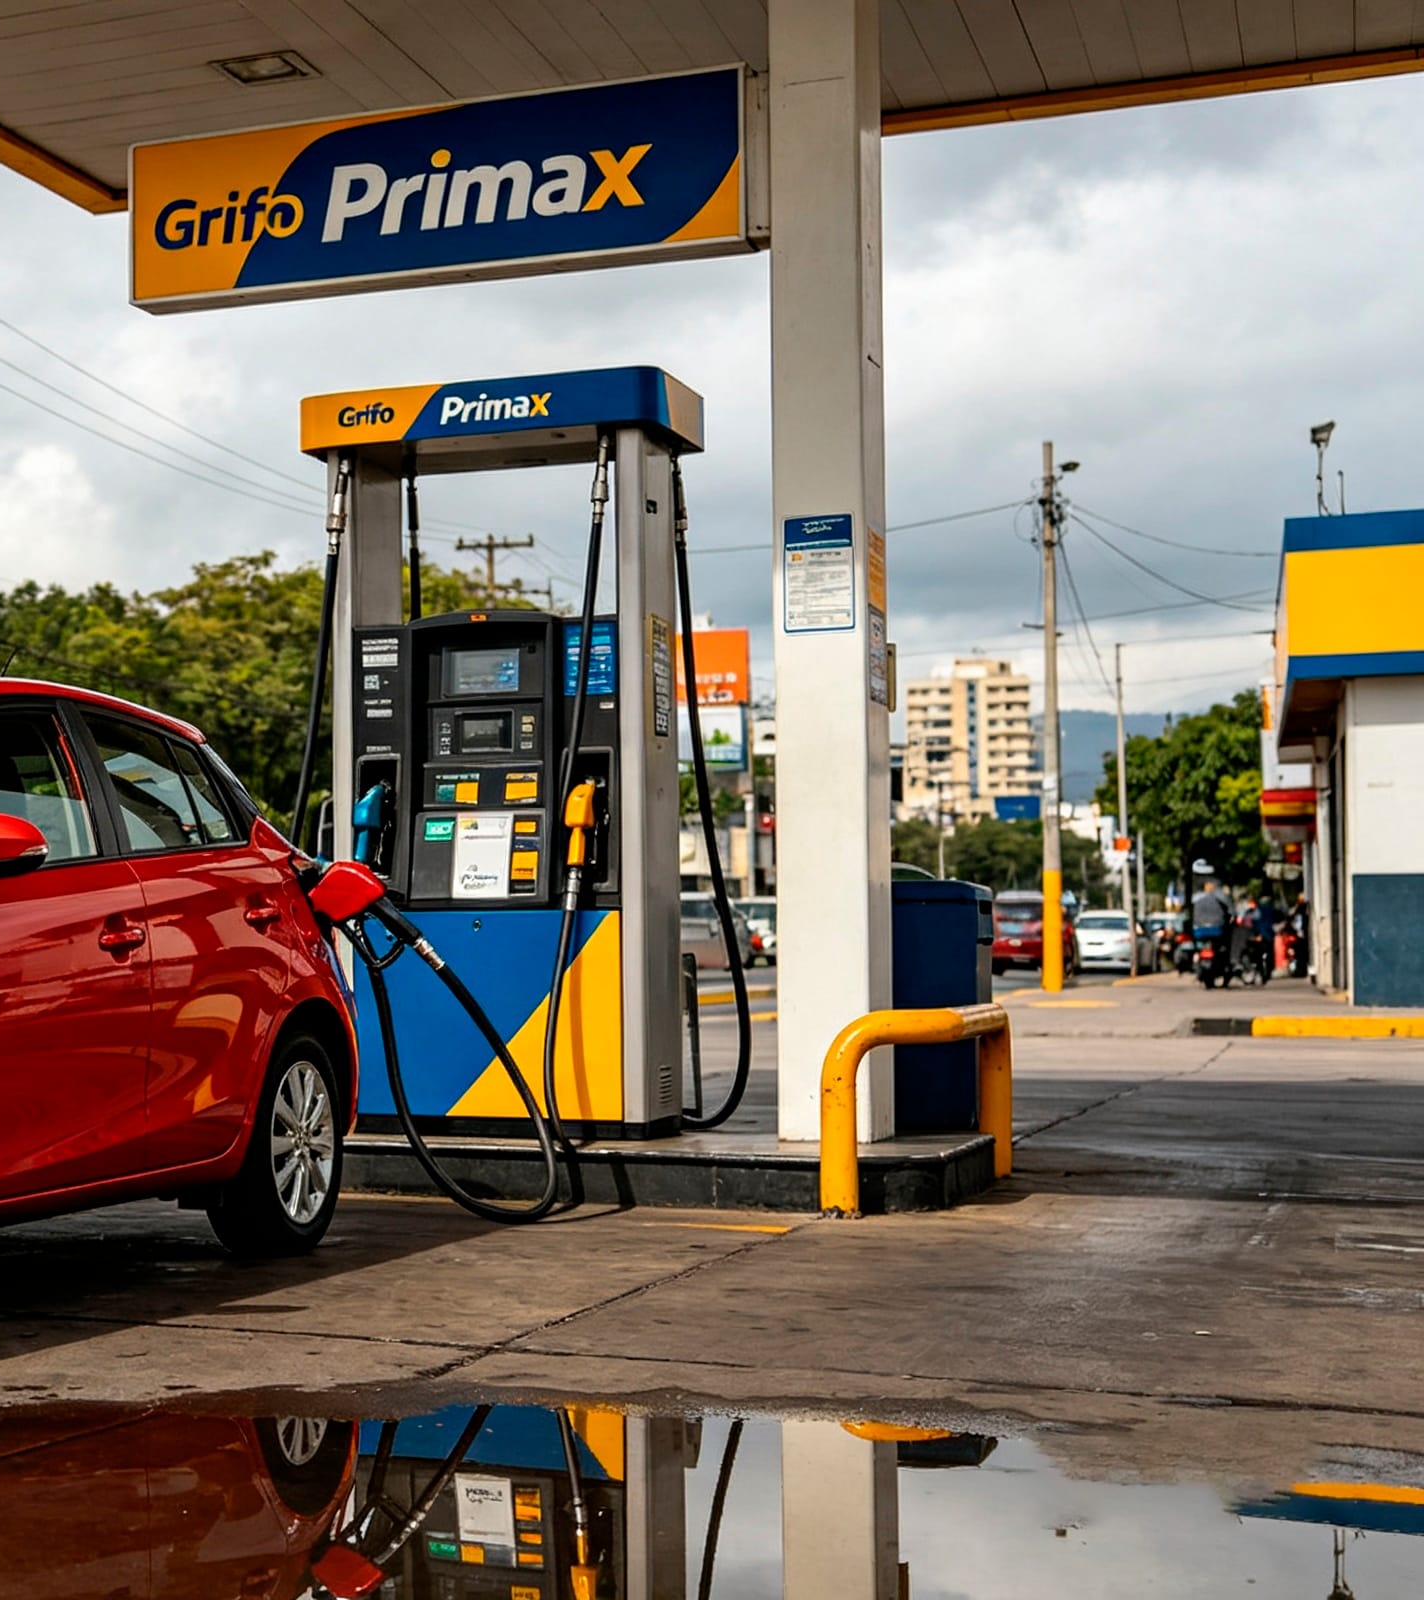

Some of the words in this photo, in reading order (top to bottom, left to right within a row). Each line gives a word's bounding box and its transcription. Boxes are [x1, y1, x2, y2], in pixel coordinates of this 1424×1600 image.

[154, 186, 304, 250] Grifo
[321, 143, 653, 243] Primax
[337, 402, 395, 428] Grifo
[439, 391, 552, 425] Primax
